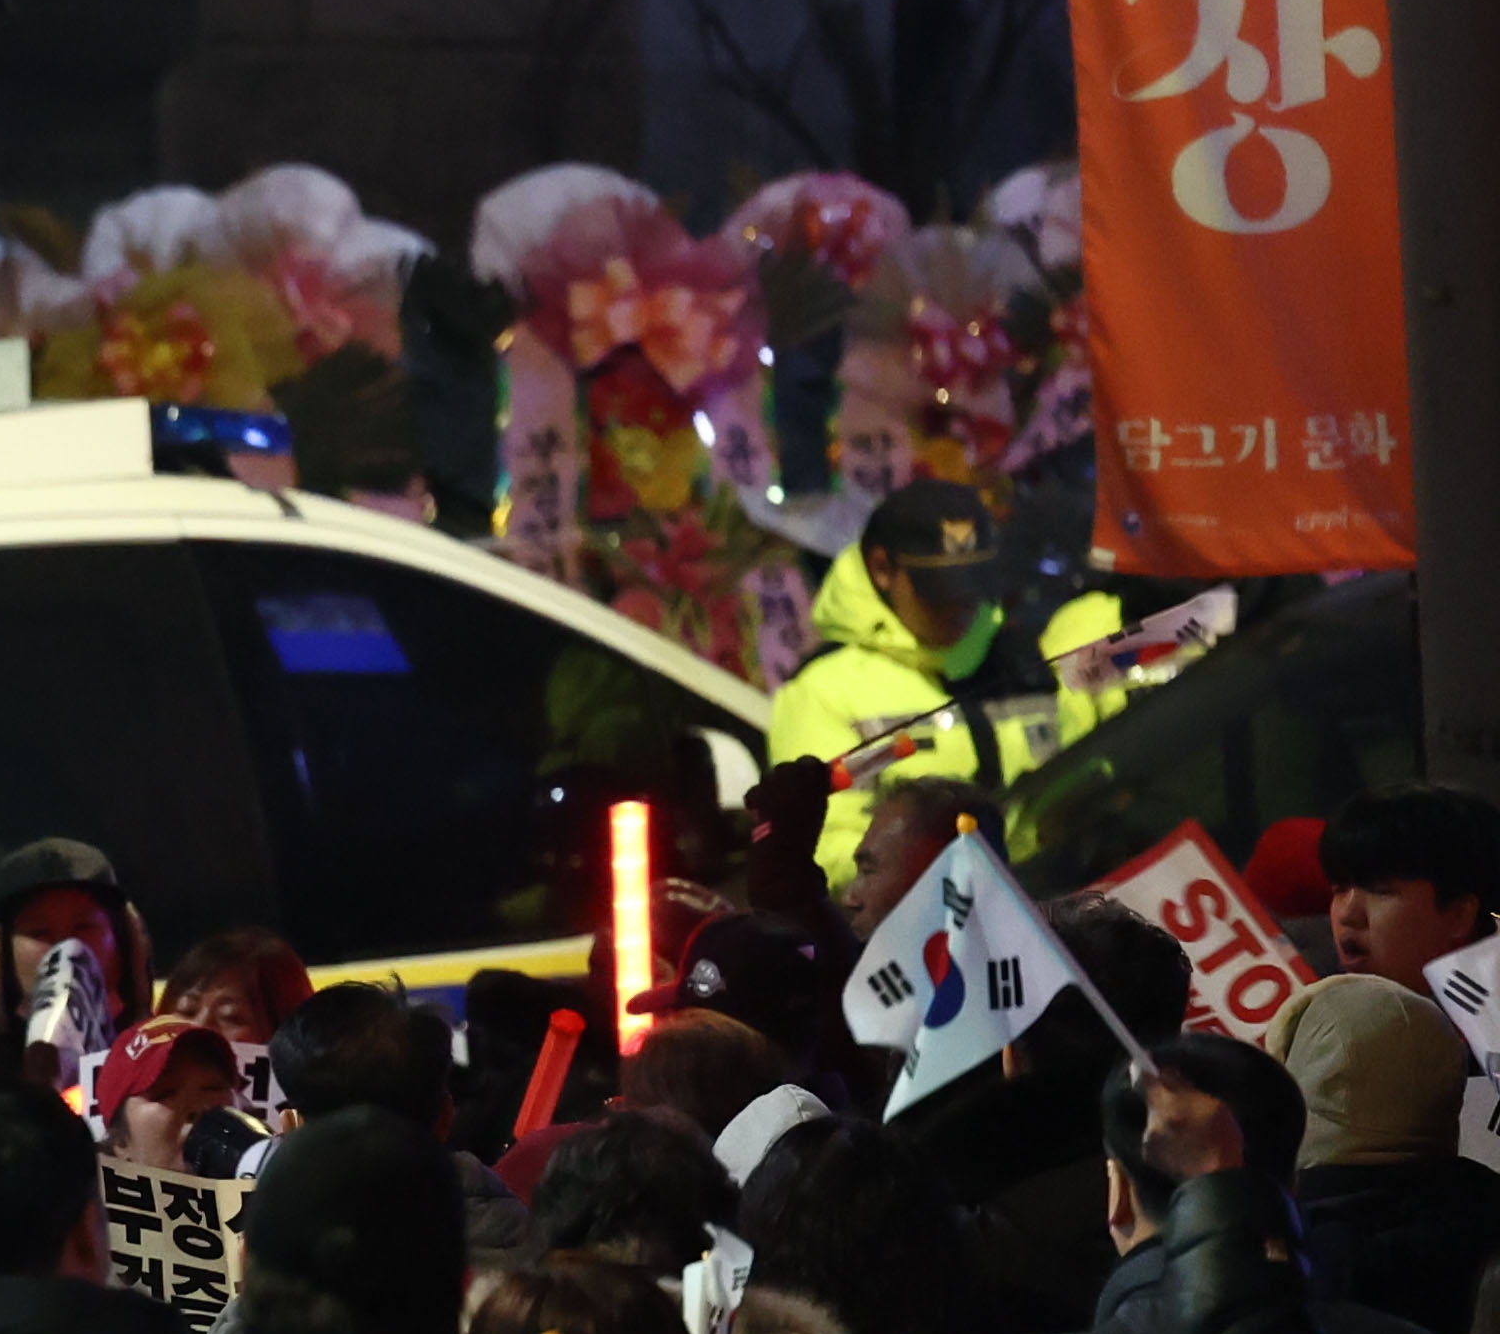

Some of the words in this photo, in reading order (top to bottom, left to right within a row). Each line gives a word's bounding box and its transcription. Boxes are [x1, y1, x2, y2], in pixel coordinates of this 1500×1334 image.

[1116, 416, 1278, 473] 담그기
[1301, 411, 1398, 472] 문화
[1160, 877, 1291, 1047] STO
